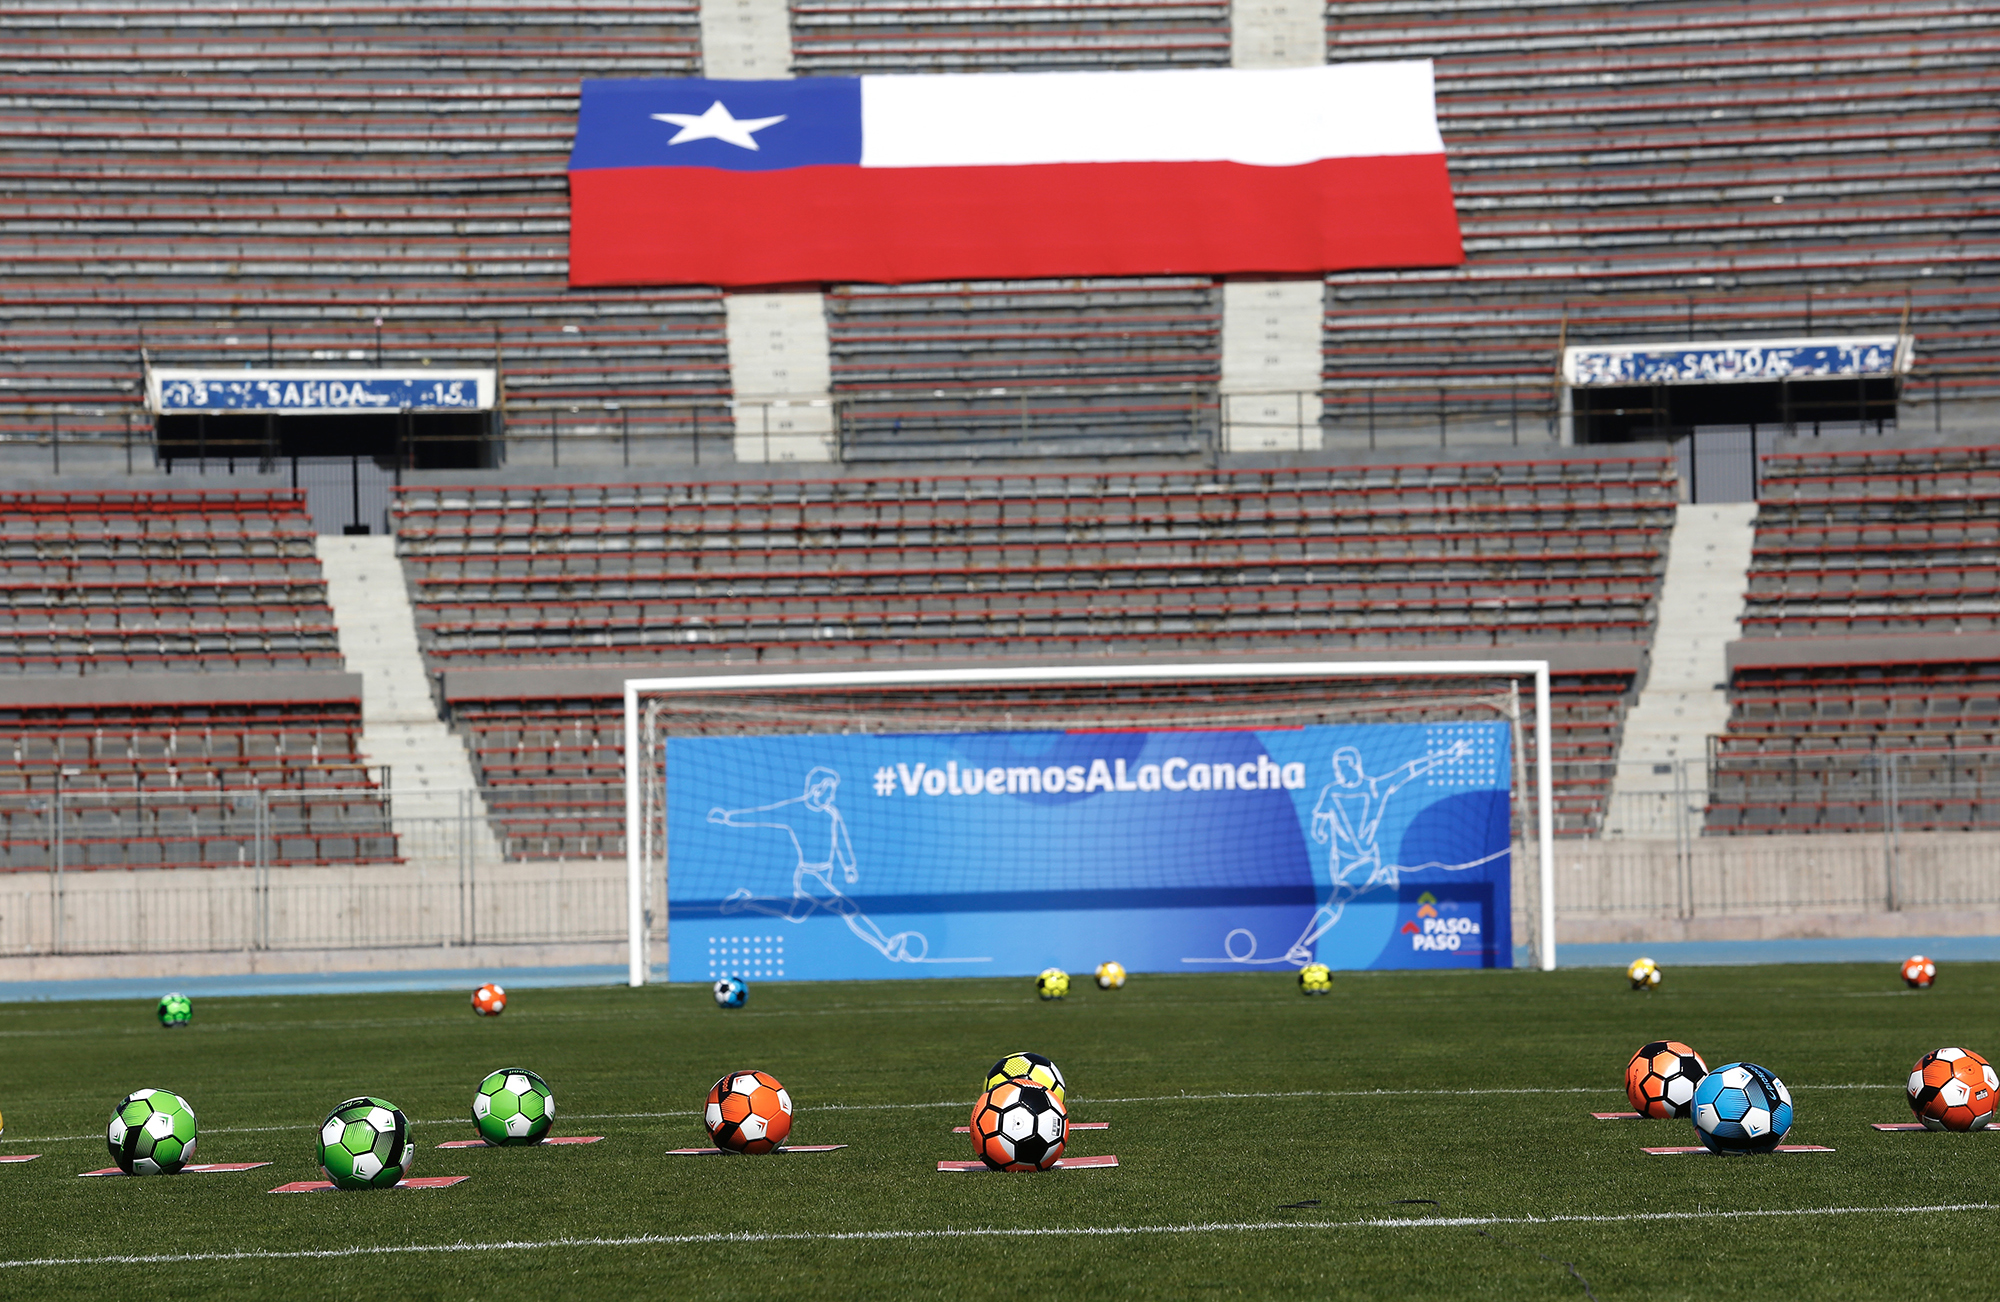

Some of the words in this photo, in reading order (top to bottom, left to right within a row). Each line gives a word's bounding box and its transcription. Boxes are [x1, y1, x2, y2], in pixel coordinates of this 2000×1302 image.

[267, 382, 366, 406] SALIDA
[433, 382, 462, 405] 15
[873, 755, 1306, 797] #VolvemosALaCancha
[1412, 934, 1461, 951] PASO
